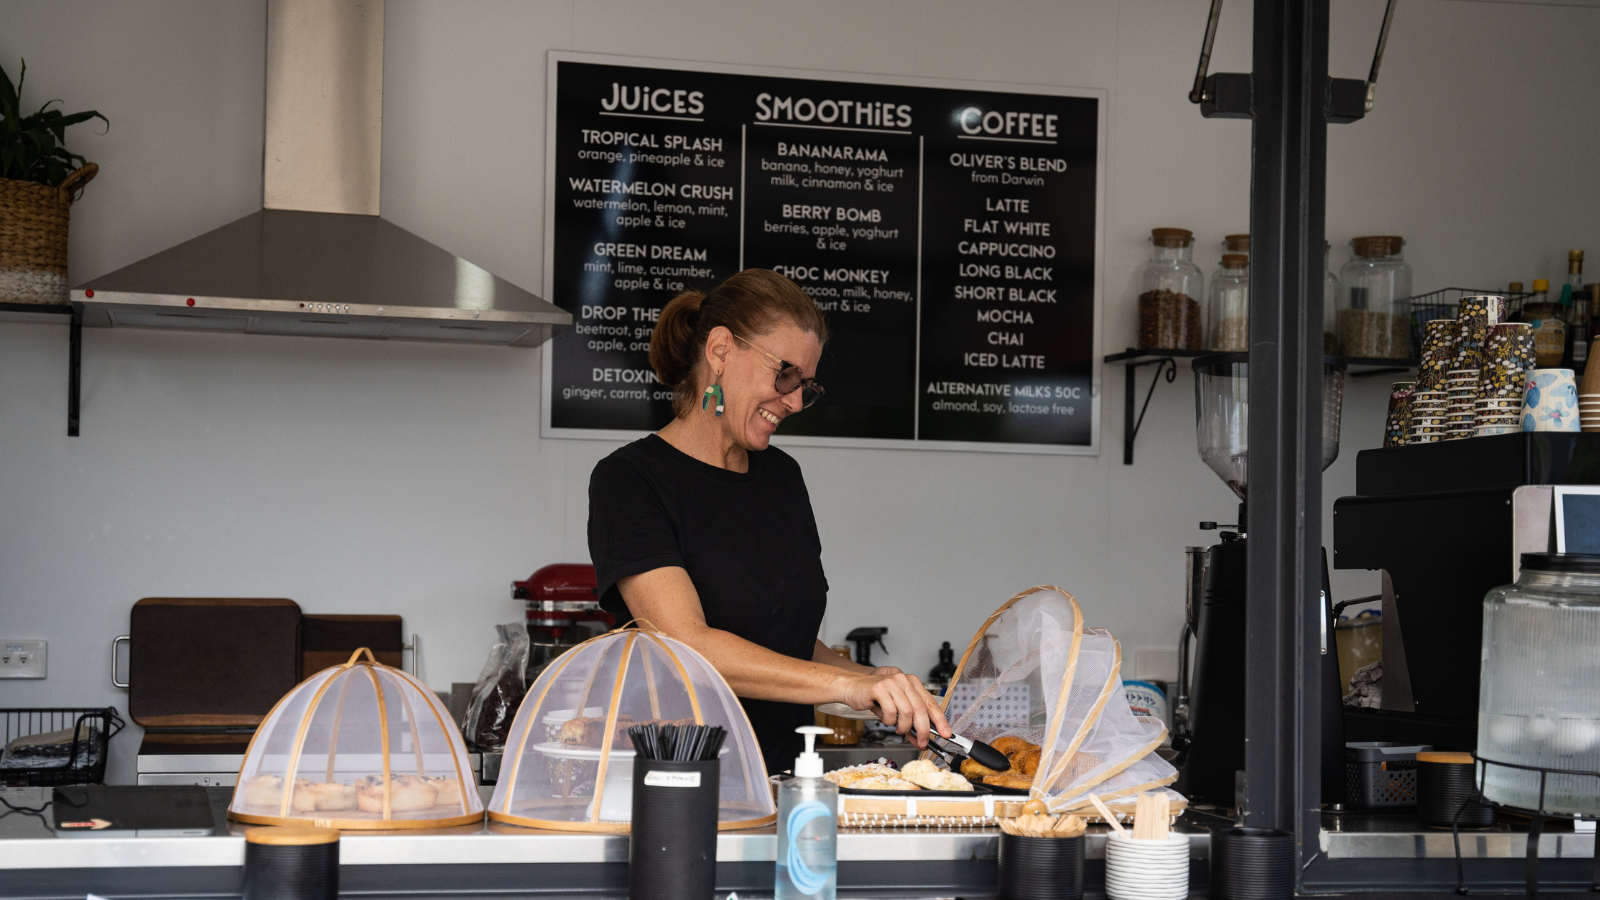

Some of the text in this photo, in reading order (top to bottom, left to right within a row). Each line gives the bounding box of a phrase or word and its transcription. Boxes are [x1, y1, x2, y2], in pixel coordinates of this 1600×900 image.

[960, 107, 1058, 138] COFFEE
[582, 130, 722, 151] TROPICAL SPLASH
[578, 149, 725, 168] orange, pineapple & ice
[778, 142, 888, 162] BANANARAMA
[762, 159, 904, 179] banana, honey, yoghurt
[950, 153, 1067, 172] OLIVER'S BLEND
[771, 175, 894, 192] milk, cinnamon & ice
[971, 171, 1044, 186] from Darwin
[569, 177, 733, 201] WATERMELON CRUSH
[573, 197, 728, 217] watermelon, lemon, mint,
[783, 204, 881, 222] BERRY BOMB
[986, 198, 1029, 213] LATTE
[616, 215, 686, 228] apple & ice
[764, 220, 899, 239] berries, apple, yoghurt
[964, 219, 1050, 236] FLAT WHITE
[594, 242, 707, 261] GREEN DREAM
[816, 238, 846, 251] & ice
[958, 241, 1056, 259] CAPPUCCINO
[584, 262, 715, 278] mint, lime, cucumber,
[824, 269, 889, 284] MONKEY
[960, 264, 1053, 281] LONG BLACK
[615, 278, 684, 291] apple & ice
[843, 286, 871, 299] milk,
[874, 287, 913, 302] honey,
[955, 286, 1057, 303] SHORT BLACK
[582, 305, 661, 321] DROP THE
[812, 298, 870, 312] hurt & ice
[977, 310, 1033, 324] MOCHA
[576, 323, 653, 339] beetroot, gin
[988, 332, 1023, 346] CHAI
[588, 339, 650, 351] apple, ora
[964, 353, 1045, 369] ICED LATTE
[593, 368, 660, 383] DETOXIN
[563, 385, 607, 400] ginger,
[610, 388, 650, 400] carrot,
[927, 382, 1010, 396] ALTERNATIVE
[1015, 386, 1051, 398] MILKS
[932, 400, 1074, 415] almond, soy, lactose free
